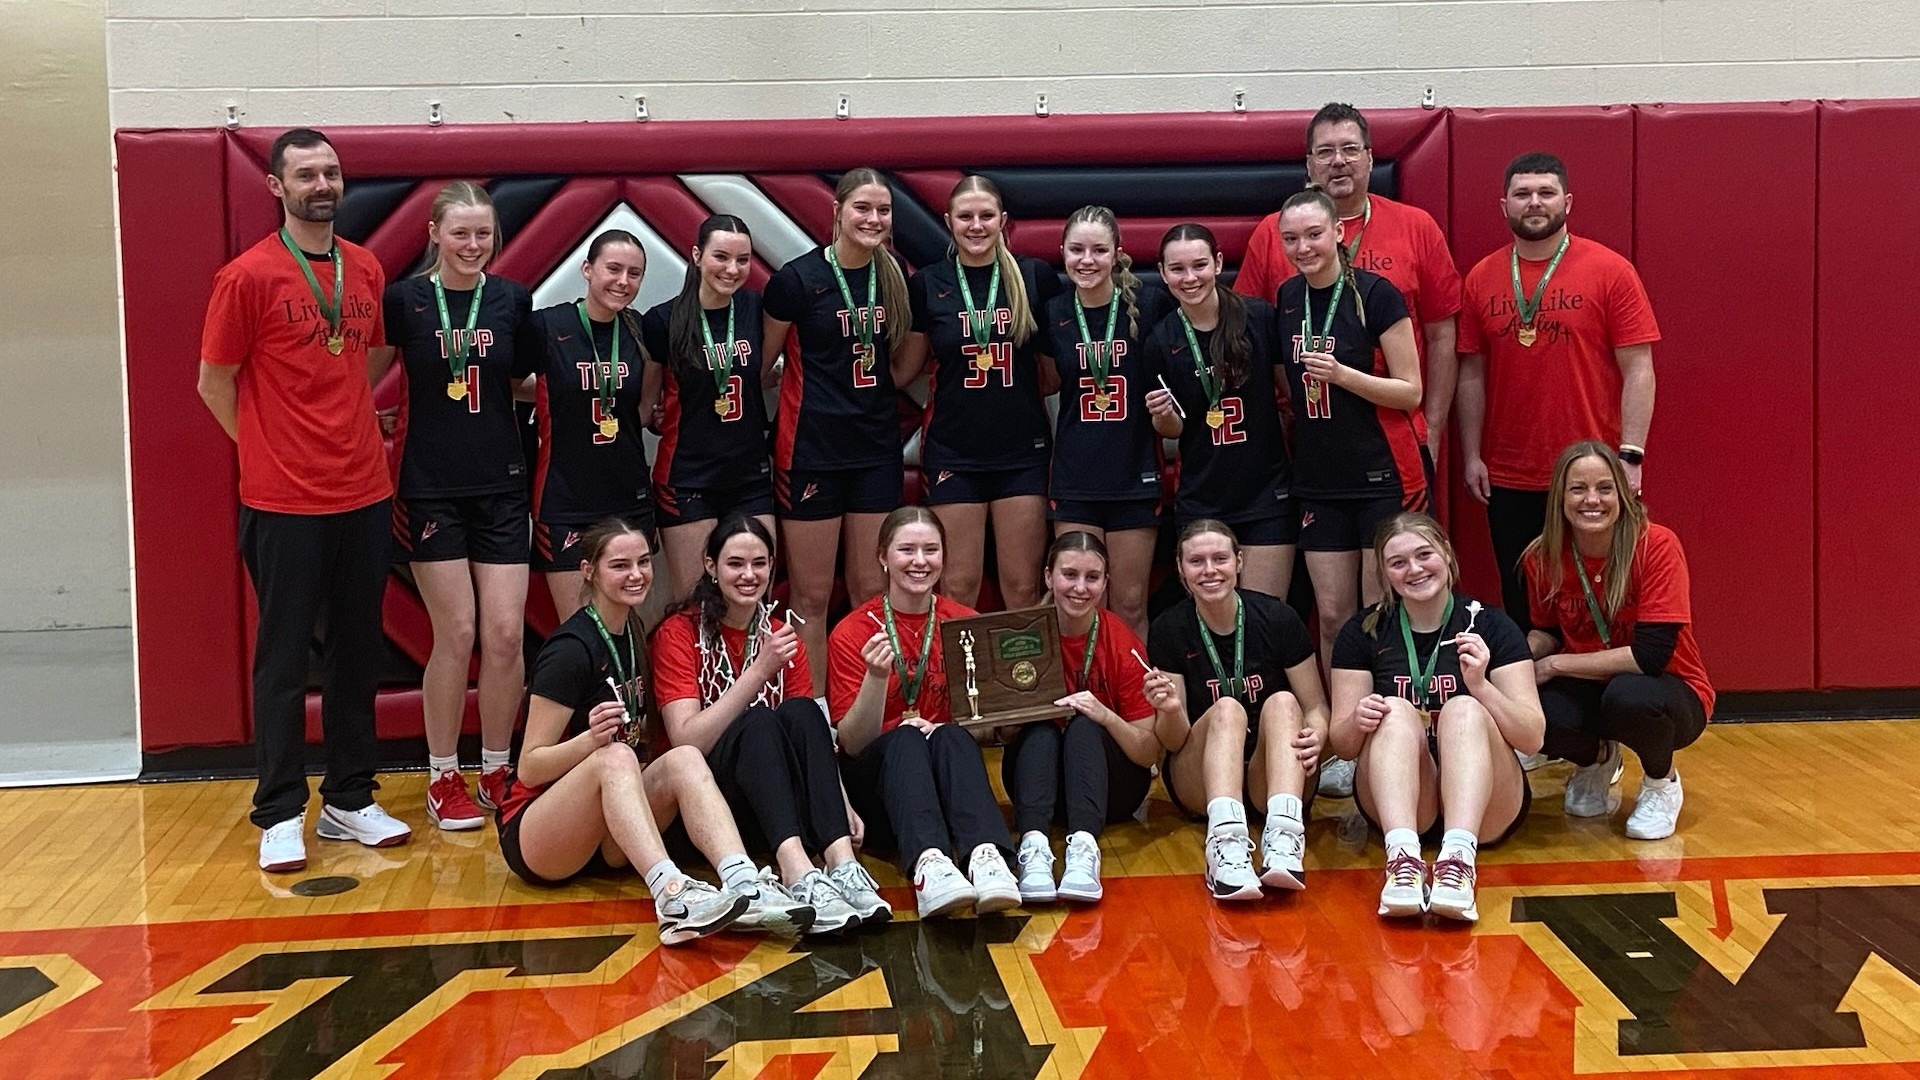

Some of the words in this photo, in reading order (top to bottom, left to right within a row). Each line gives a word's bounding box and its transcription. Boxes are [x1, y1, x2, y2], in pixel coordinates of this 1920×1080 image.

[1361, 250, 1393, 271] ike
[283, 298, 328, 324] Liv
[1489, 294, 1530, 317] Liv
[298, 320, 362, 353] Asley
[836, 305, 886, 338] TPP
[1497, 314, 1563, 344] Aley
[1292, 334, 1336, 364] TP
[852, 342, 877, 389] 2
[961, 341, 1013, 389] 34
[1079, 375, 1127, 421] 23
[1206, 674, 1264, 704] TP
